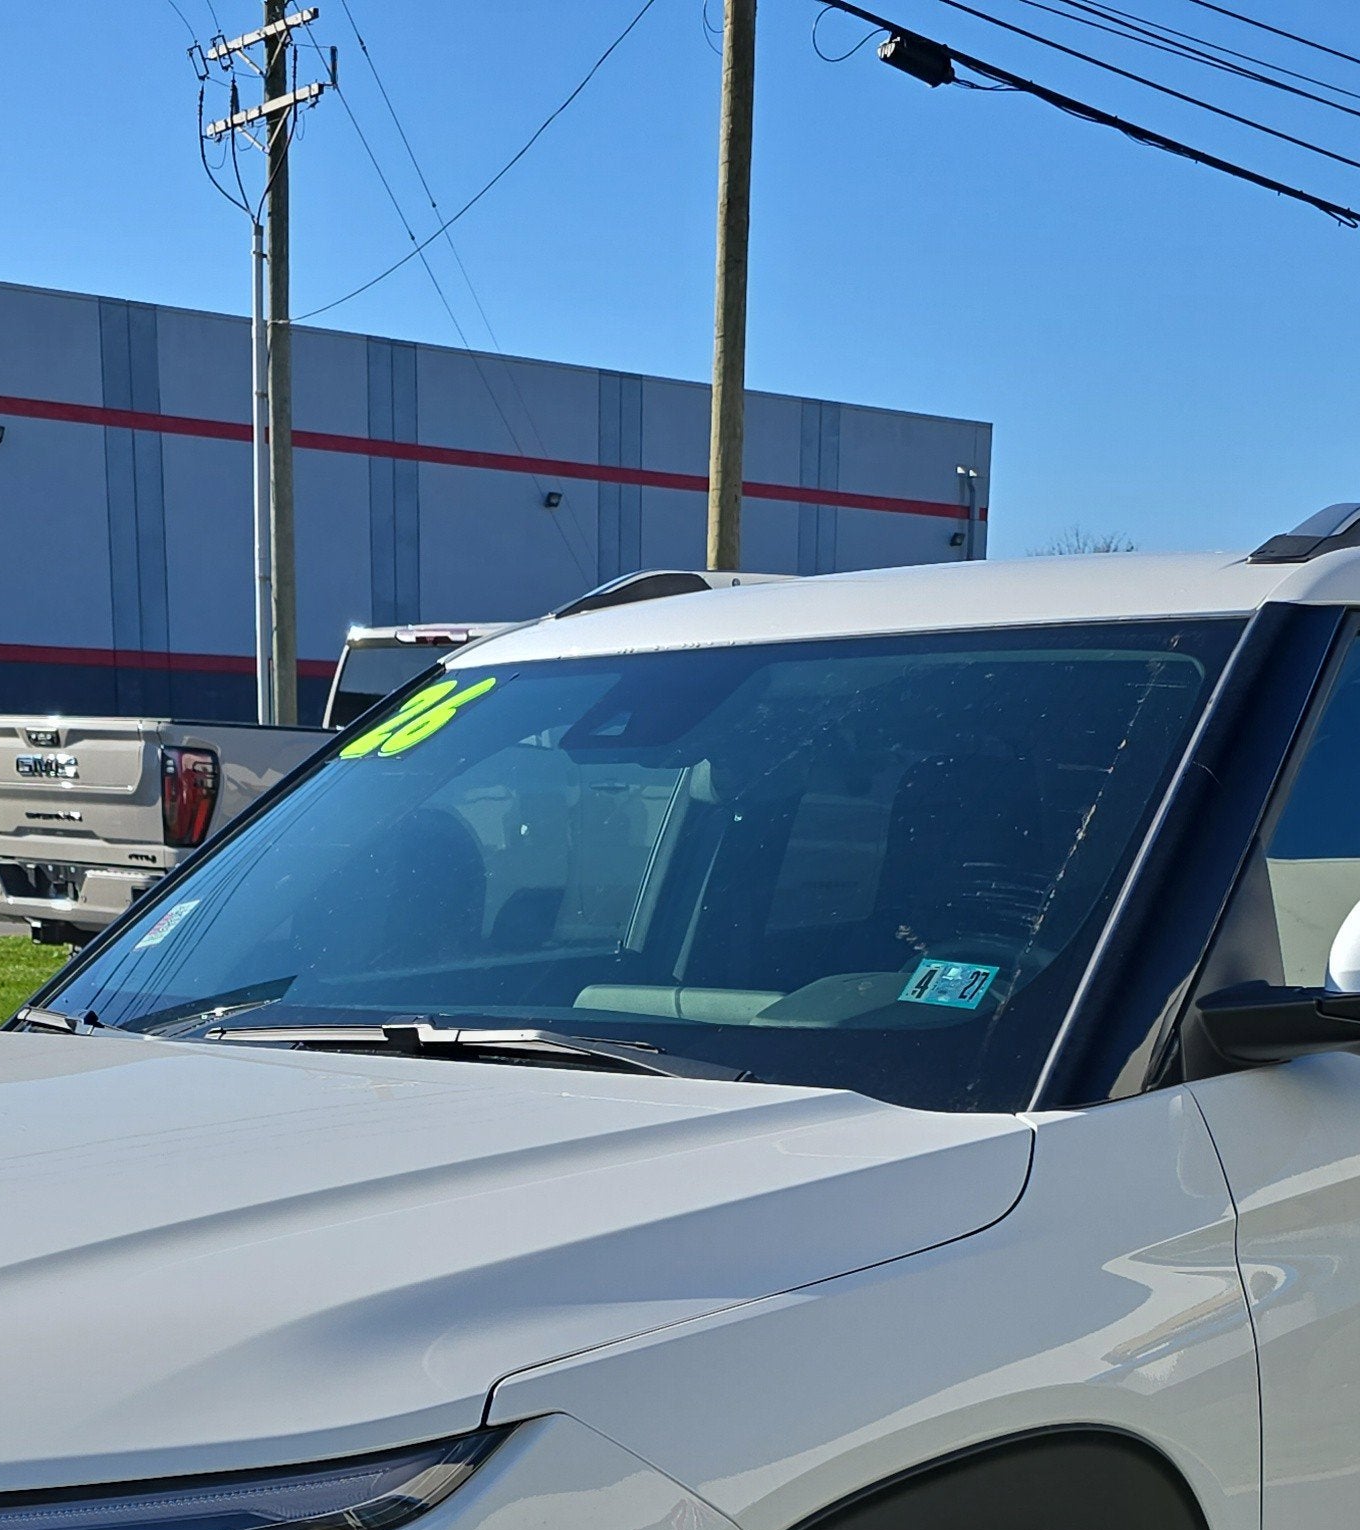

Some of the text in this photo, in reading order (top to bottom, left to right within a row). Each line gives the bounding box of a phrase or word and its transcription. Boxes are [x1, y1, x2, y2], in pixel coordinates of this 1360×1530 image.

[339, 677, 496, 760] 26
[912, 969, 990, 1001] 4 27
